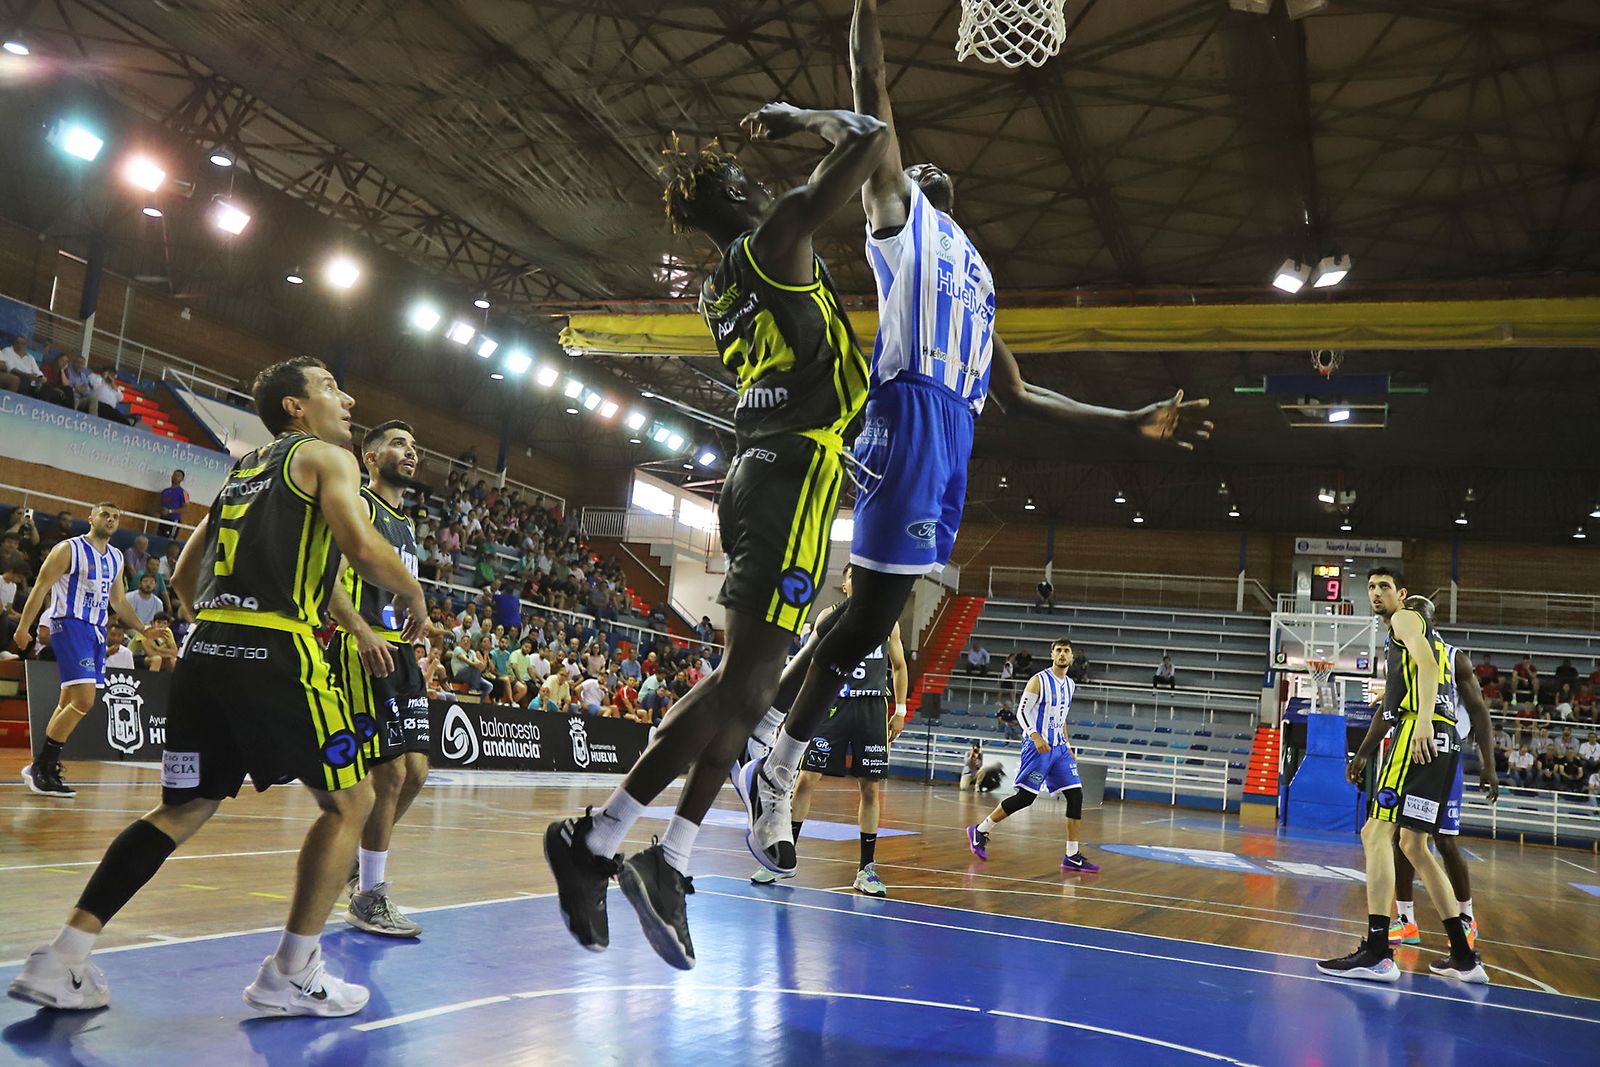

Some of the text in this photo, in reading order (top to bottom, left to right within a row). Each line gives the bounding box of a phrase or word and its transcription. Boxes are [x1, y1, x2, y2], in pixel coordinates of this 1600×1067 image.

[0, 395, 27, 416] La
[31, 407, 100, 436] emoción
[103, 423, 119, 441] de
[123, 433, 171, 455] ganar
[172, 443, 201, 465] debe
[1326, 580, 1340, 600] 9
[479, 715, 541, 740] baloncesto
[590, 751, 619, 763] HUELVA
